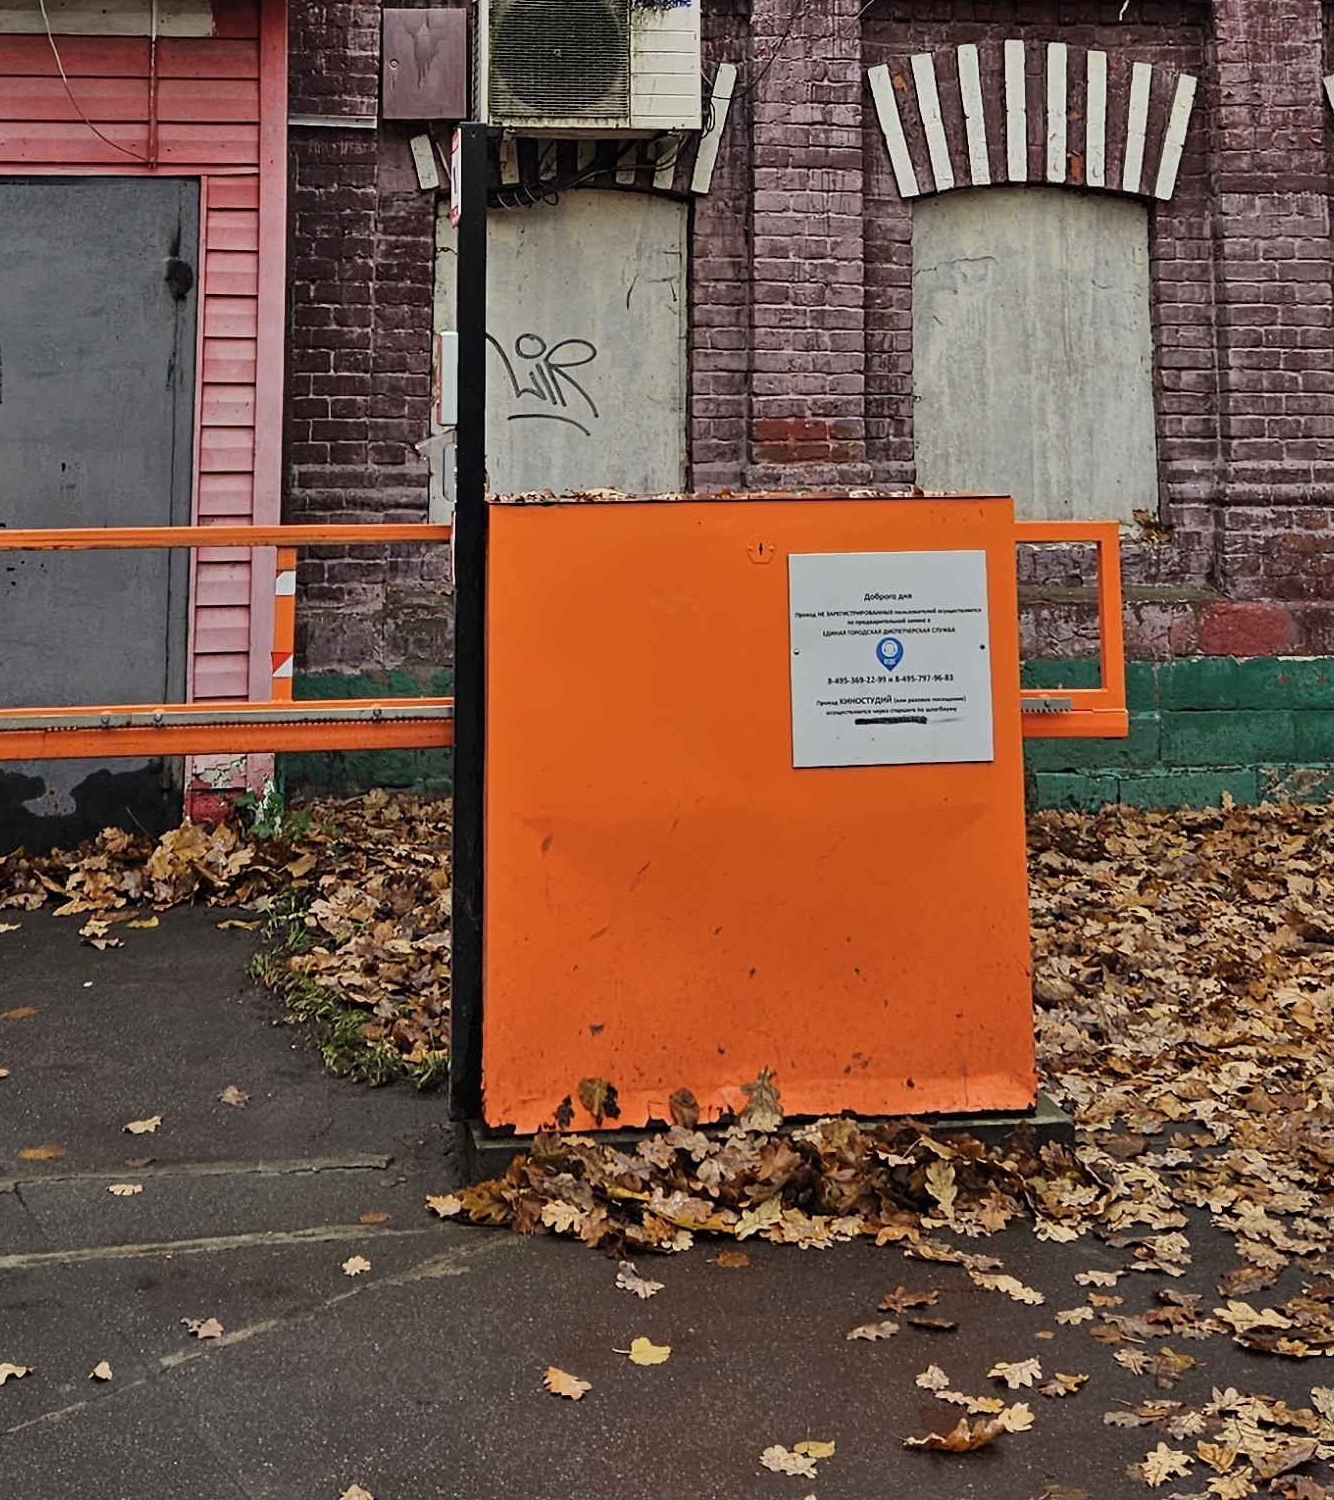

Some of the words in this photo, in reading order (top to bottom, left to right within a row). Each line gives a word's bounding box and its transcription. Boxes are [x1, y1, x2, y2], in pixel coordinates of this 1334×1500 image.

[863, 593, 897, 602] Доброго
[794, 611, 817, 619] Проезд
[826, 609, 894, 617] ЗАРЕГИСТРИРОВАННЫХ
[822, 629, 847, 637] ЕДИНАЯ
[847, 628, 882, 636] ГОРОДСКАЯ
[882, 627, 931, 635] ДИСПЕТЧЕРСКАЯ
[827, 676, 887, 685] 8-495-369-22-99
[839, 695, 893, 706] КИНОСТУДИЙ
